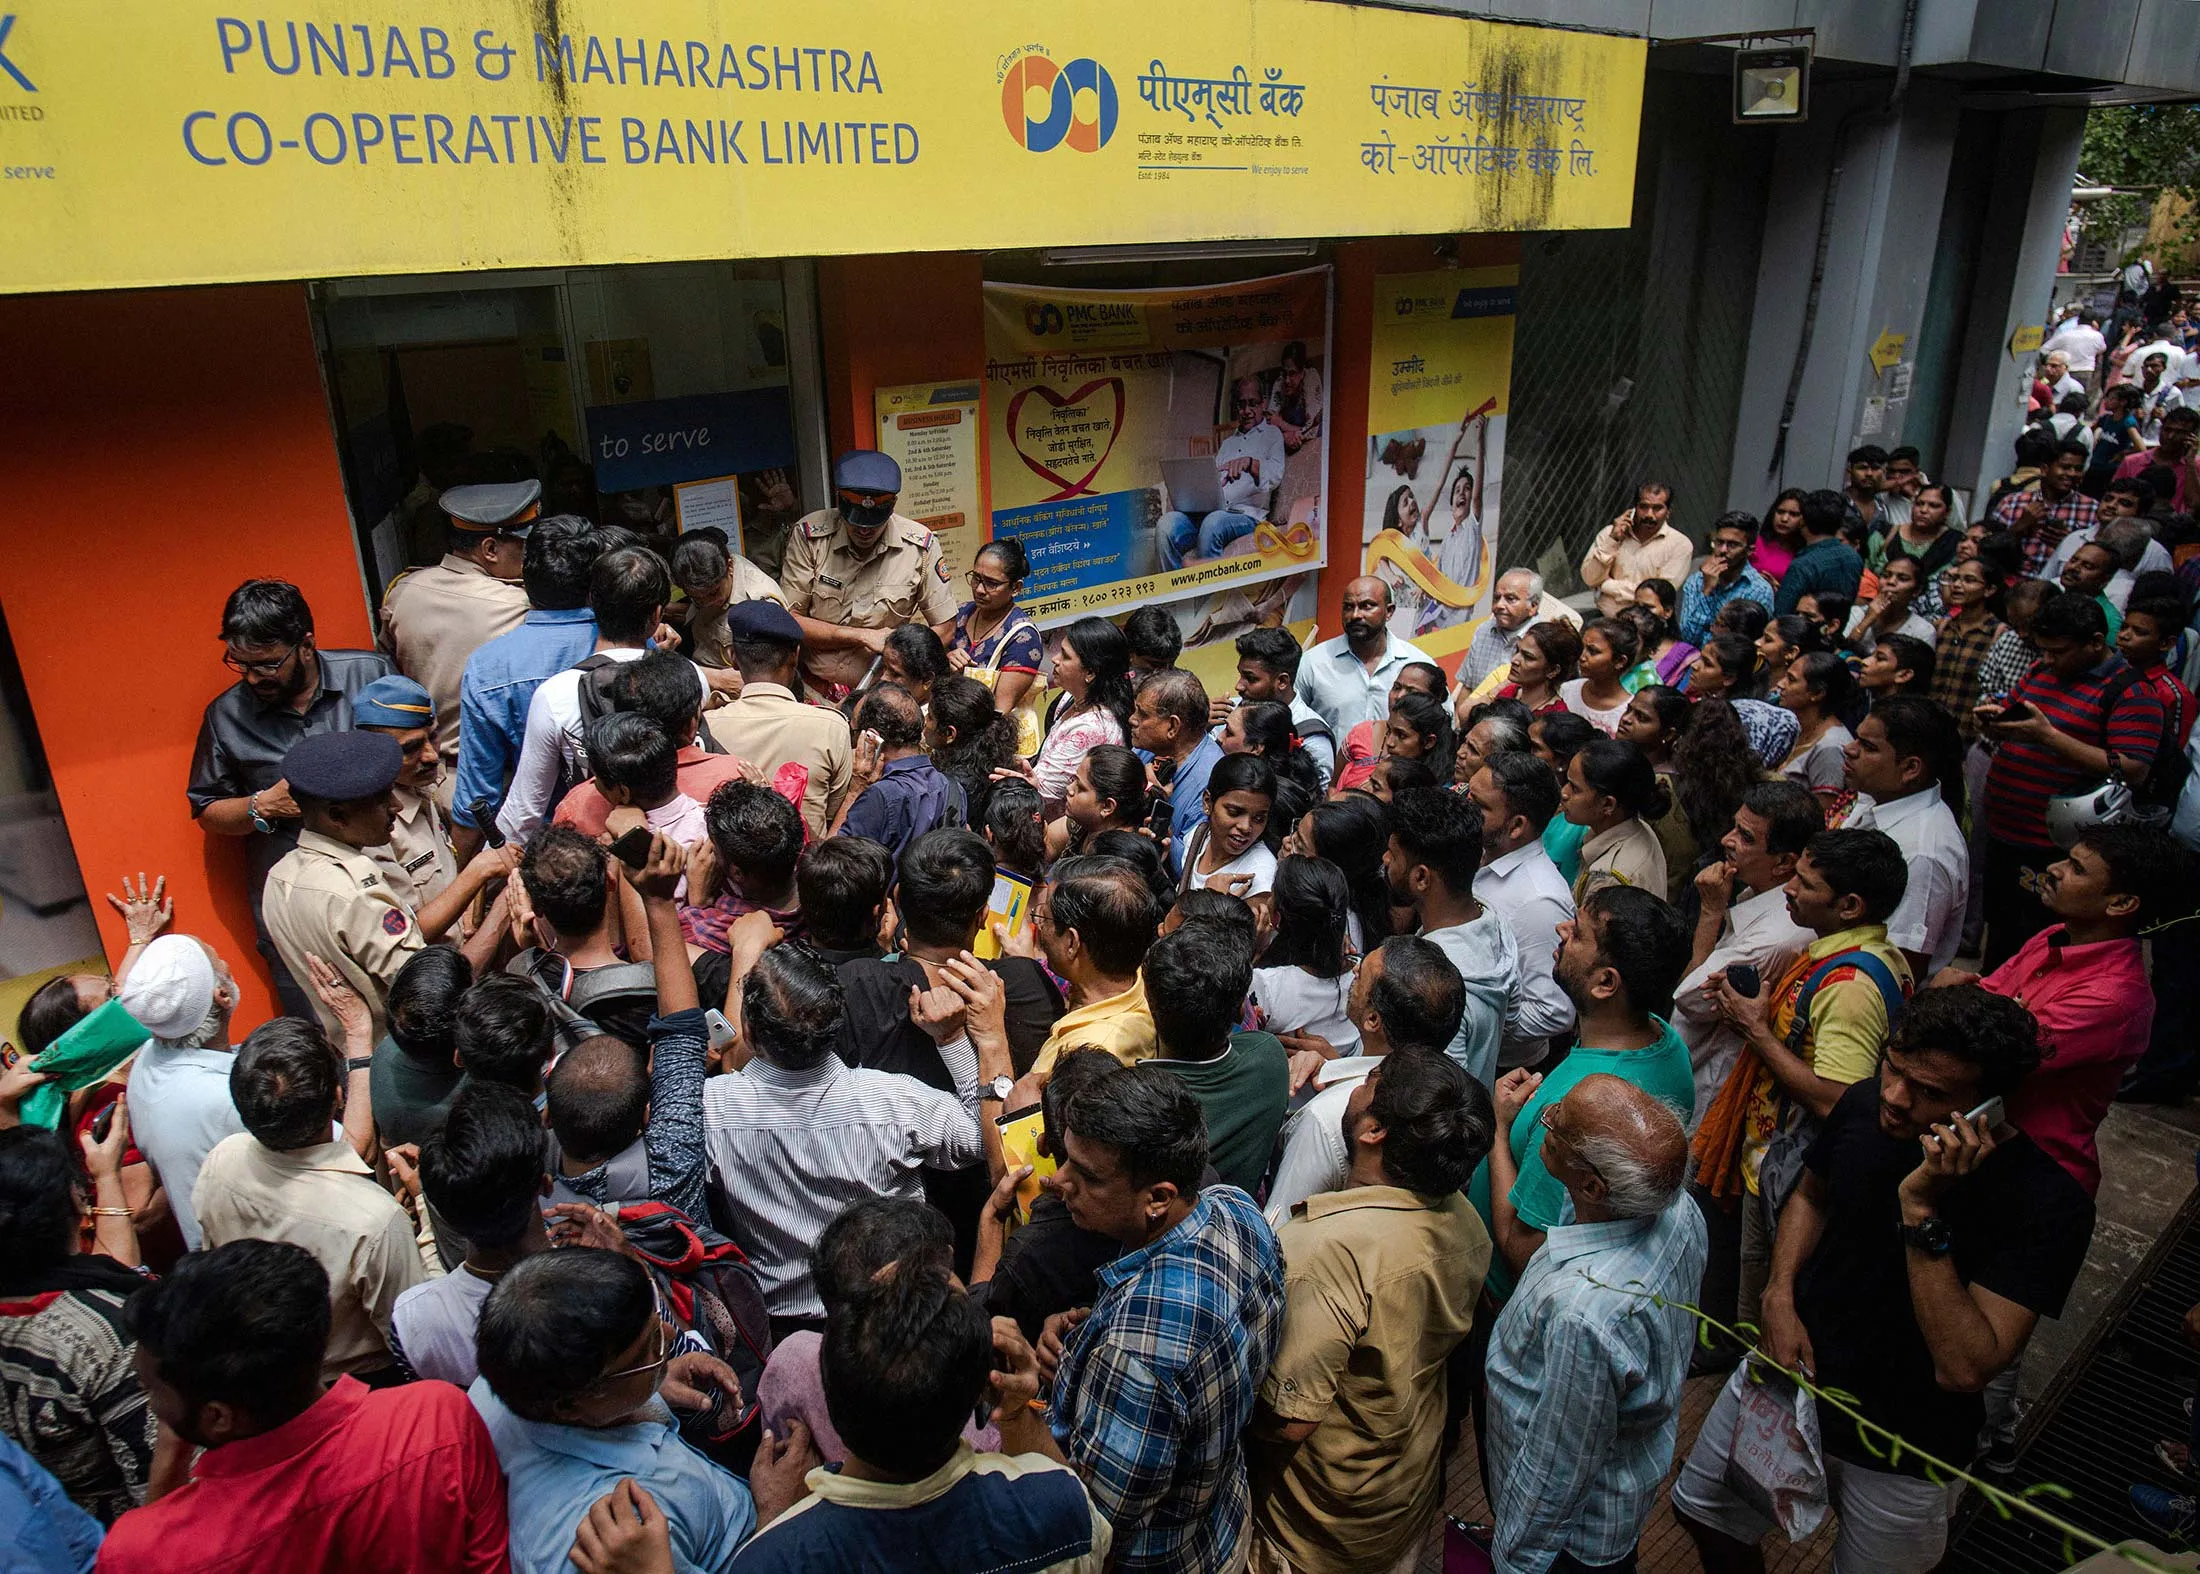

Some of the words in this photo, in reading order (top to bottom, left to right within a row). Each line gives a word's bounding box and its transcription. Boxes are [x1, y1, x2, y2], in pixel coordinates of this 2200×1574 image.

[215, 17, 456, 80] PUNJAB
[474, 30, 517, 81] &
[534, 33, 884, 95] MAHARASHTRA
[0, 105, 45, 121] ITED
[1370, 74, 1442, 119] पंजाब
[1510, 95, 1586, 133] महाराष्ट्र
[181, 110, 607, 166] CO-OPERATIVE
[620, 116, 749, 165] BANK
[760, 120, 920, 165] LIMITED
[1138, 134, 1161, 145] पंजाब
[1569, 139, 1599, 176] लि.
[4, 166, 56, 180] serve
[1154, 172, 1170, 181] 1984
[1252, 165, 1261, 174] We
[1264, 166, 1282, 177] enjoy
[1283, 167, 1290, 175] to
[1291, 167, 1309, 175] serve
[1067, 304, 1097, 321] PMC
[1099, 304, 1137, 320] BANK
[986, 357, 1038, 385] पीएमसी
[1110, 354, 1144, 372] बचत
[1391, 354, 1425, 376] उम्मीद
[1054, 423, 1070, 436] वेतन
[1071, 423, 1090, 434] बचत
[599, 434, 629, 459] to
[641, 426, 711, 455] serve
[1031, 545, 1047, 560] इतर
[1170, 557, 1263, 588] www.pmcbank.com
[1039, 597, 1072, 616] क्रमांक
[1081, 593, 1108, 607] १८००
[1111, 587, 1132, 599] २२३
